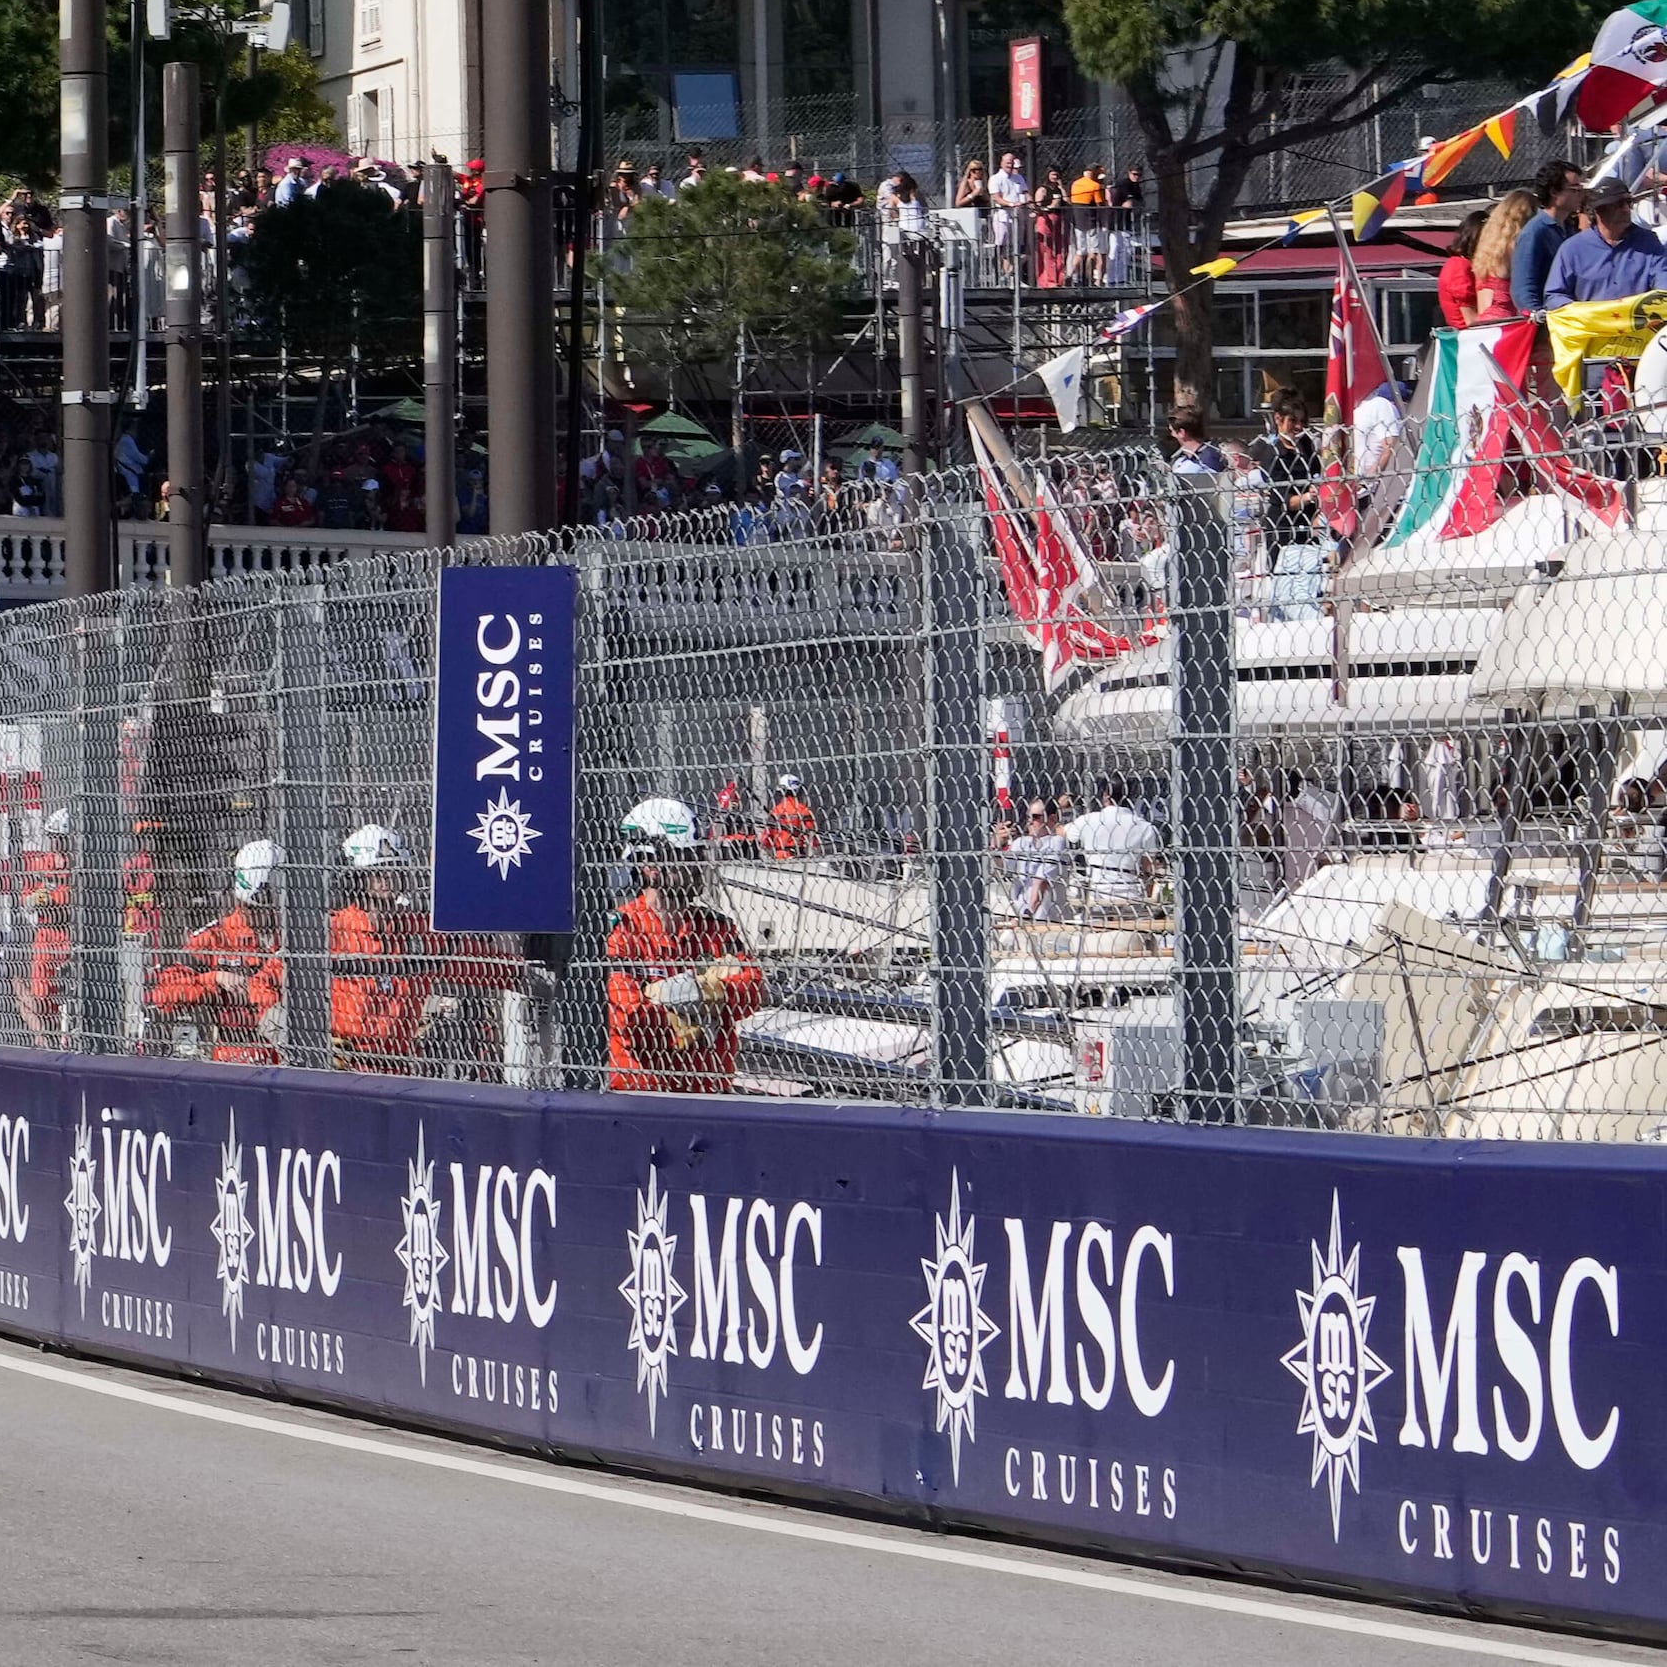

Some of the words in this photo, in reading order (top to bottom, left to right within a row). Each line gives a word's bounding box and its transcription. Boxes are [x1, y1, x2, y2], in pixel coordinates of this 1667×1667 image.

[476, 613, 521, 781] MSC
[529, 613, 543, 781] CRUISES
[102, 1128, 172, 1268] MSC
[256, 1145, 343, 1297] MSC
[450, 1162, 558, 1329] MSC
[102, 1290, 174, 1340] CRUISES
[256, 1322, 345, 1375] CRUISES
[689, 1194, 824, 1376] MSC
[1004, 1218, 1175, 1418] MSC
[452, 1353, 559, 1414] CRUISES
[1396, 1246, 1620, 1471] MSC
[690, 1403, 826, 1468] CRUISES
[1005, 1446, 1178, 1519] CRUISES
[1398, 1499, 1621, 1585] CRUISES
